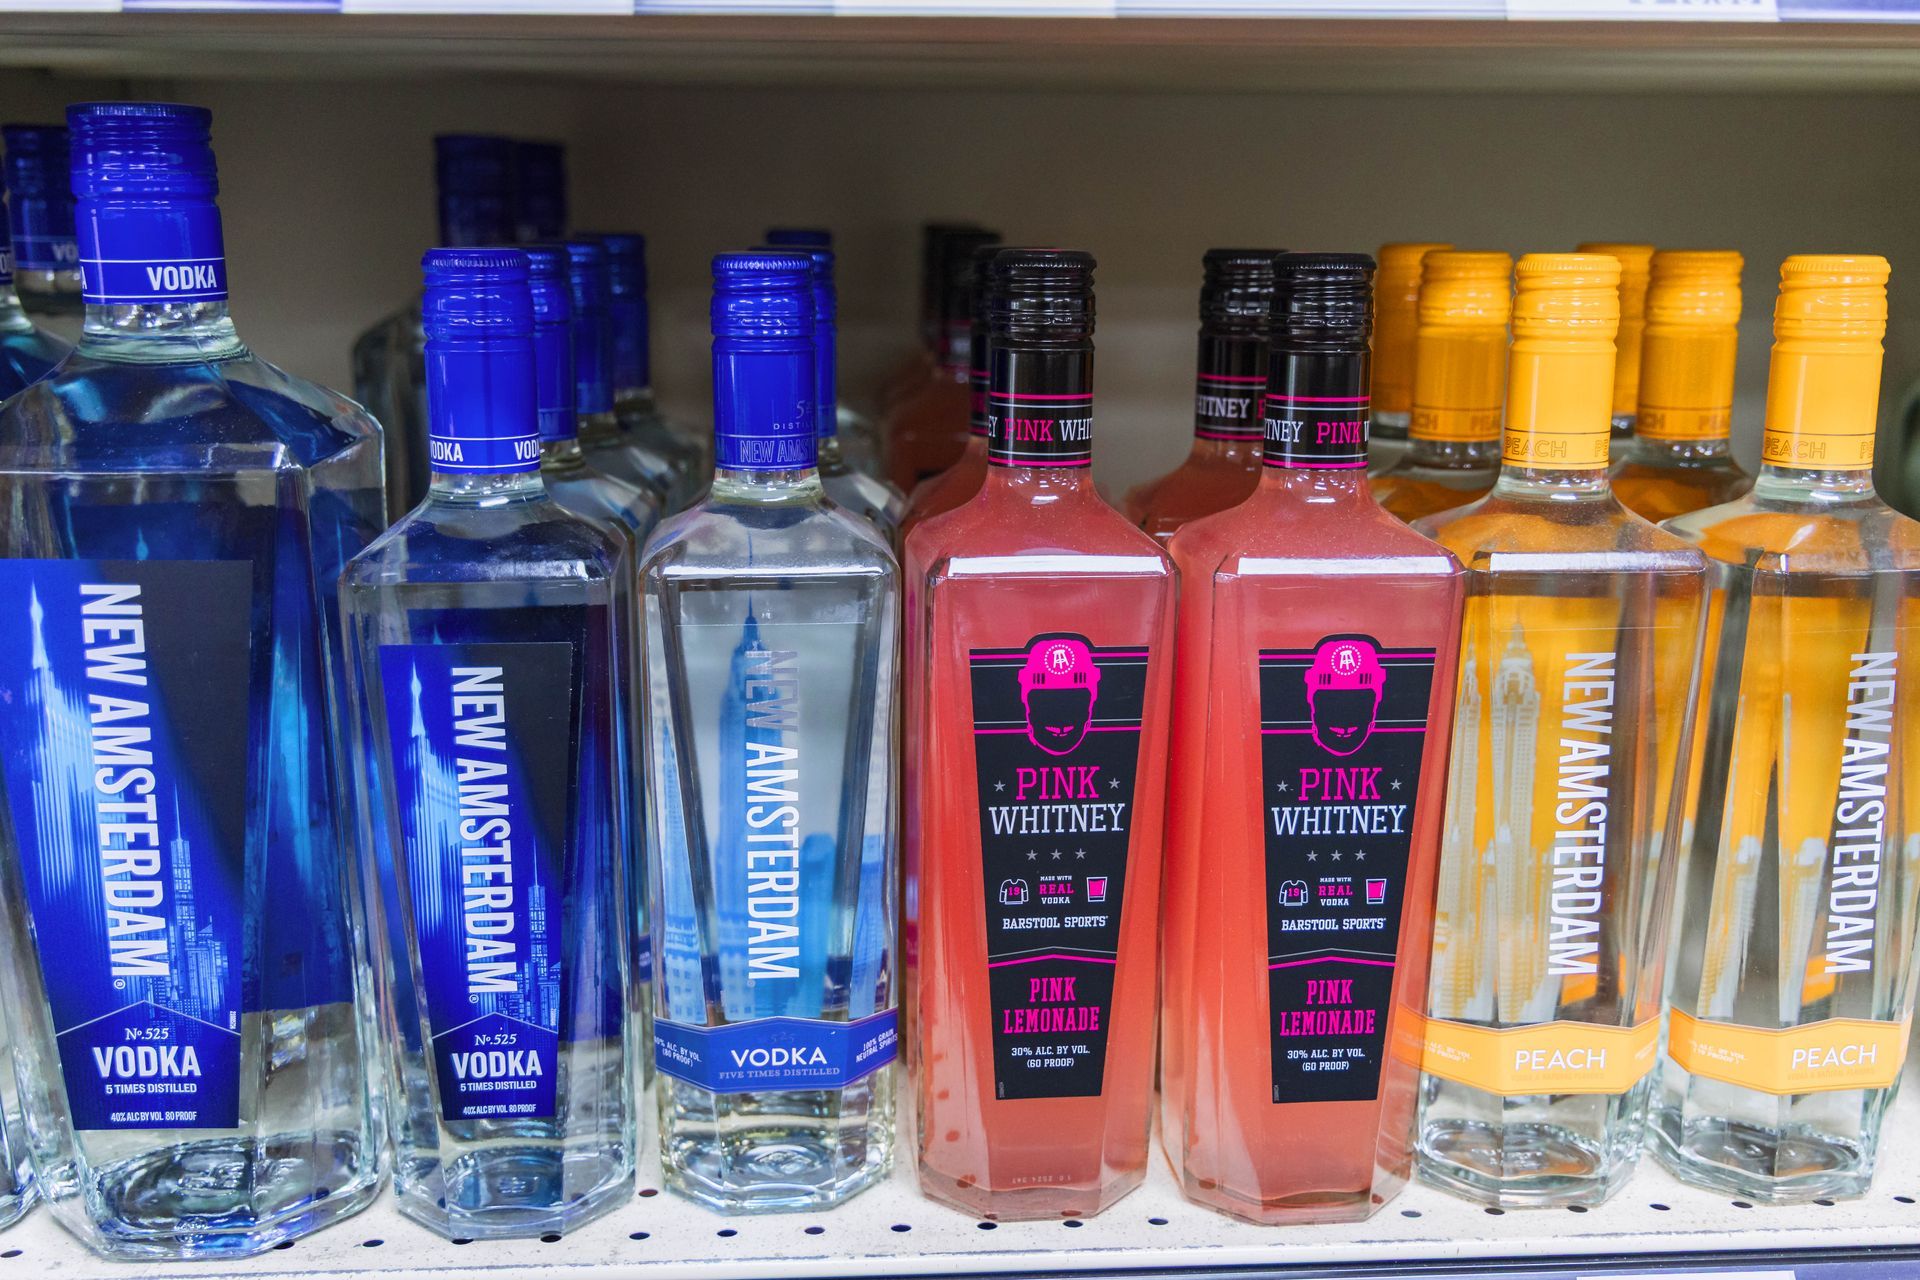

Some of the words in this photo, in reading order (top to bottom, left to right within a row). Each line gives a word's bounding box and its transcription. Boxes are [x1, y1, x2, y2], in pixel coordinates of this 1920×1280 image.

[147, 265, 217, 291] VODKA
[1004, 417, 1054, 441] PINK
[1316, 421, 1361, 444] PINK
[740, 440, 775, 463] NEW
[80, 584, 147, 686] NEW
[745, 650, 799, 733] NEW
[1562, 652, 1616, 734] NEW
[1845, 651, 1898, 733] NEW
[452, 666, 507, 750] NEW
[1016, 766, 1100, 800] PINK
[1298, 767, 1382, 801] PINK
[988, 803, 1125, 834] WHITNEY
[1271, 805, 1406, 836] WHITNEY
[746, 742, 800, 979] AMSTERDAM
[1548, 738, 1610, 975] AMSTERDAM
[1824, 738, 1890, 974] AMSTERDAM
[1039, 884, 1075, 895] REAL
[1318, 885, 1353, 896] REAL
[1002, 918, 1060, 930] BARSTOOL
[1064, 916, 1108, 927] SPORTS
[1282, 919, 1338, 931] BARSTOOL
[1342, 918, 1386, 929] SPORTS
[1029, 977, 1076, 1002] PINK
[1306, 980, 1354, 1004] PINK
[1003, 1006, 1100, 1034] LEMONADE
[1280, 1009, 1376, 1036] LEMONADE
[93, 1045, 202, 1078] VODKA
[731, 1046, 828, 1068] VODKA
[1011, 1047, 1032, 1056] 30%
[1035, 1046, 1054, 1055] ALC.
[1056, 1046, 1069, 1054] BY
[1072, 1045, 1090, 1054] VOL.
[1287, 1050, 1308, 1059] 30%
[1310, 1050, 1330, 1058] ALC.
[1332, 1049, 1344, 1058] BY
[1346, 1048, 1366, 1057] VOL.
[1515, 1048, 1606, 1071] PEACH
[1792, 1043, 1878, 1070] PEACH
[452, 1050, 543, 1079] VODKA
[719, 1071, 745, 1080] FIVE
[747, 1070, 781, 1078] TIMES
[784, 1068, 840, 1076] DISTILLED
[1026, 1059, 1041, 1068] (60
[1044, 1058, 1074, 1068] PROOF)
[1302, 1062, 1316, 1071] (60
[1319, 1061, 1350, 1070] PROOF)
[106, 1084, 113, 1094] 5
[114, 1084, 146, 1094] TIMES
[147, 1083, 198, 1093] DISTILLED
[460, 1083, 466, 1092] 5
[467, 1082, 494, 1092] TIMES
[495, 1080, 537, 1090] DISTILLED
[110, 1112, 126, 1122] 40%
[126, 1112, 140, 1121] ALC
[140, 1112, 150, 1121] BY
[150, 1112, 164, 1120] VOL
[165, 1112, 174, 1120] 80
[176, 1111, 198, 1120] PROOF
[476, 1106, 488, 1114] ALC
[488, 1105, 496, 1114] BY
[509, 1104, 517, 1112] 80
[518, 1104, 537, 1112] PROOF
